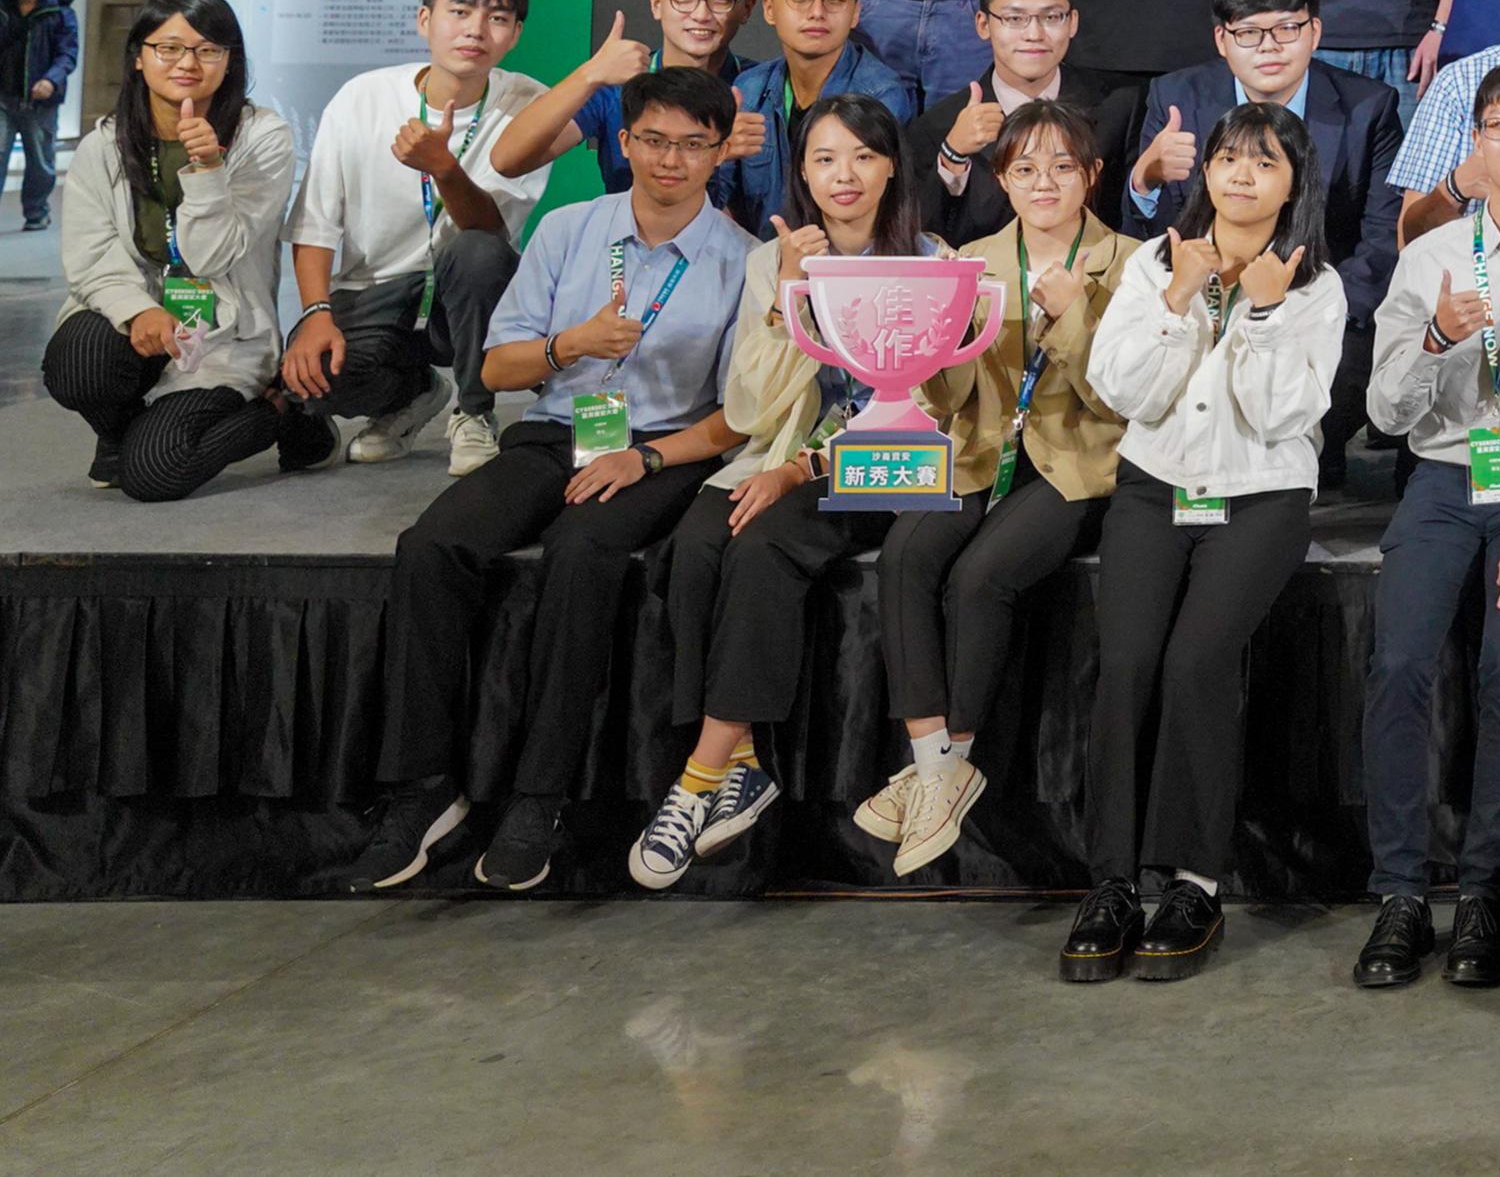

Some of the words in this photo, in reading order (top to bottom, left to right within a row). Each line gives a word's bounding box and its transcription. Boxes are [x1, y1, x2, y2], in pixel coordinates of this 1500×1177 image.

[1473, 251, 1495, 328] CHANGE
[872, 285, 914, 370] 佳作
[1482, 327, 1500, 368] NOW
[844, 465, 937, 486] 新秀大賽
